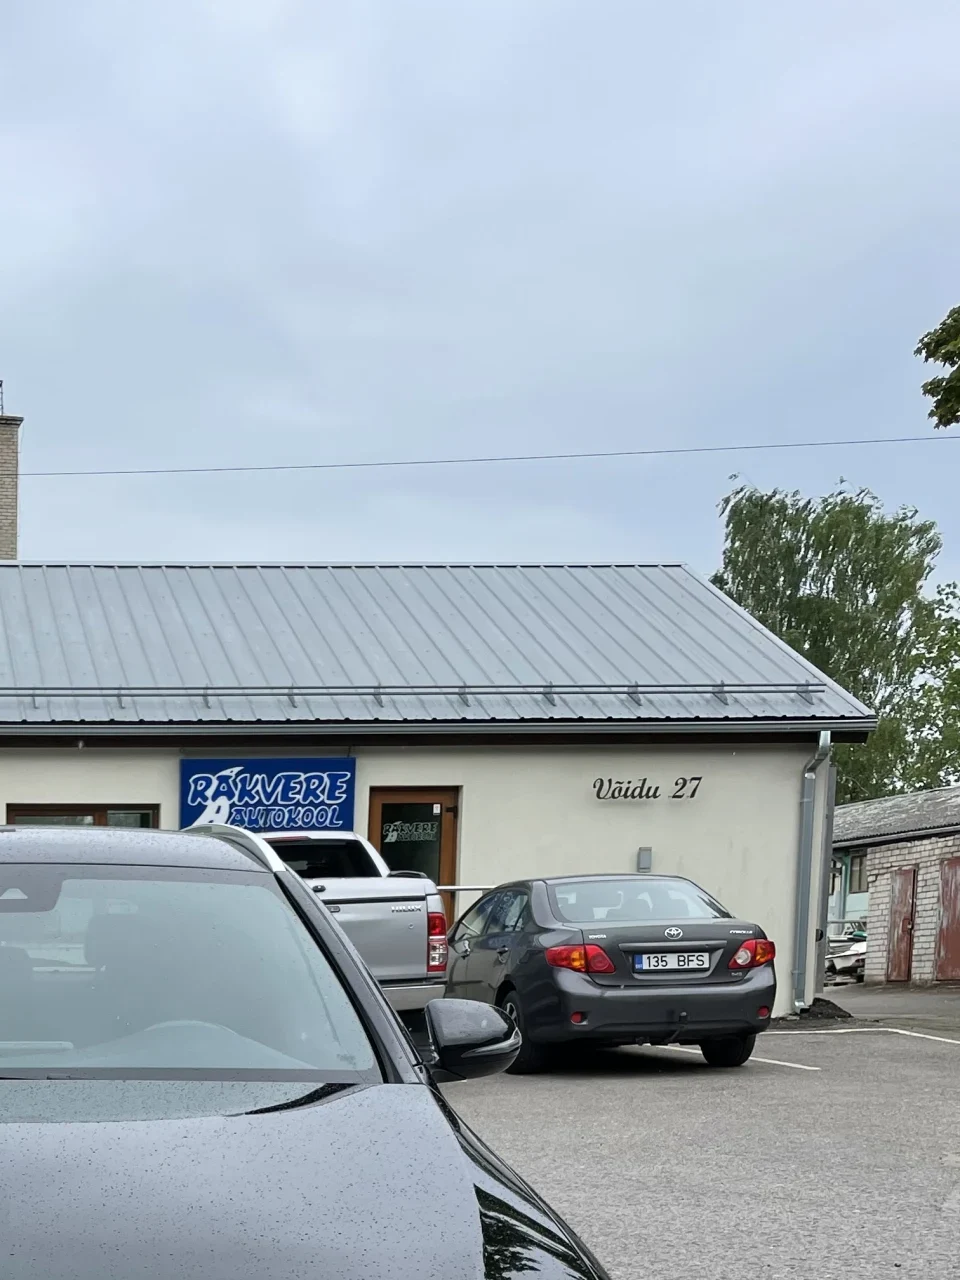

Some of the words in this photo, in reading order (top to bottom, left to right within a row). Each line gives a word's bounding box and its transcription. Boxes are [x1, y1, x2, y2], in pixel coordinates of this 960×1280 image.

[187, 772, 352, 806] RAKVERE
[593, 777, 661, 799] Võidu
[668, 776, 703, 799] 27
[228, 805, 343, 828] AUTOKOOL
[383, 821, 439, 835] RAKVERE
[647, 955, 668, 968] 135
[677, 954, 705, 967] BFS
